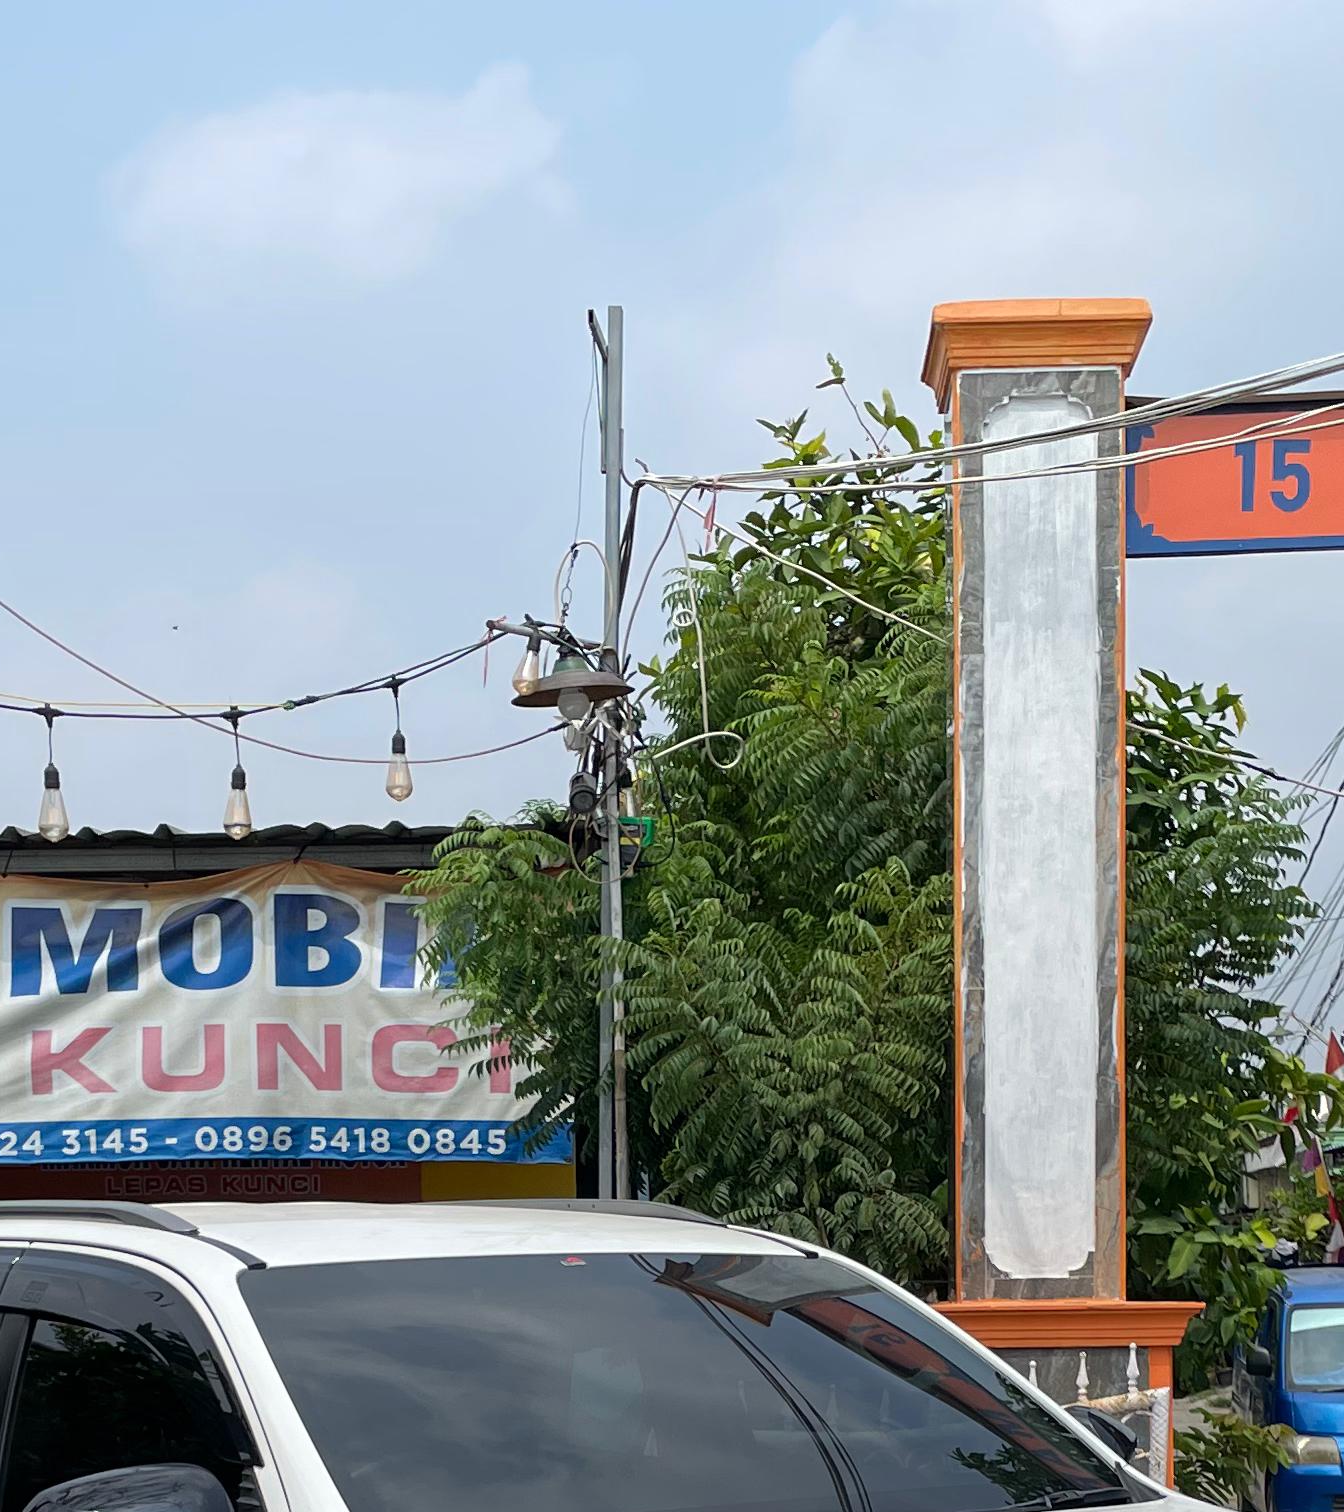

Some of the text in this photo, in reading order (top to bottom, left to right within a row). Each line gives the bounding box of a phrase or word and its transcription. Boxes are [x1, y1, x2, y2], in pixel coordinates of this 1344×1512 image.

[1235, 440, 1311, 512] 15
[31, 1023, 511, 1093] KUNCI
[61, 1127, 149, 1155] 3145
[194, 1125, 292, 1152] 0896
[309, 1126, 390, 1153] 5418
[407, 1128, 506, 1155] 0845
[106, 1174, 322, 1195] LEPAS KUNCI
